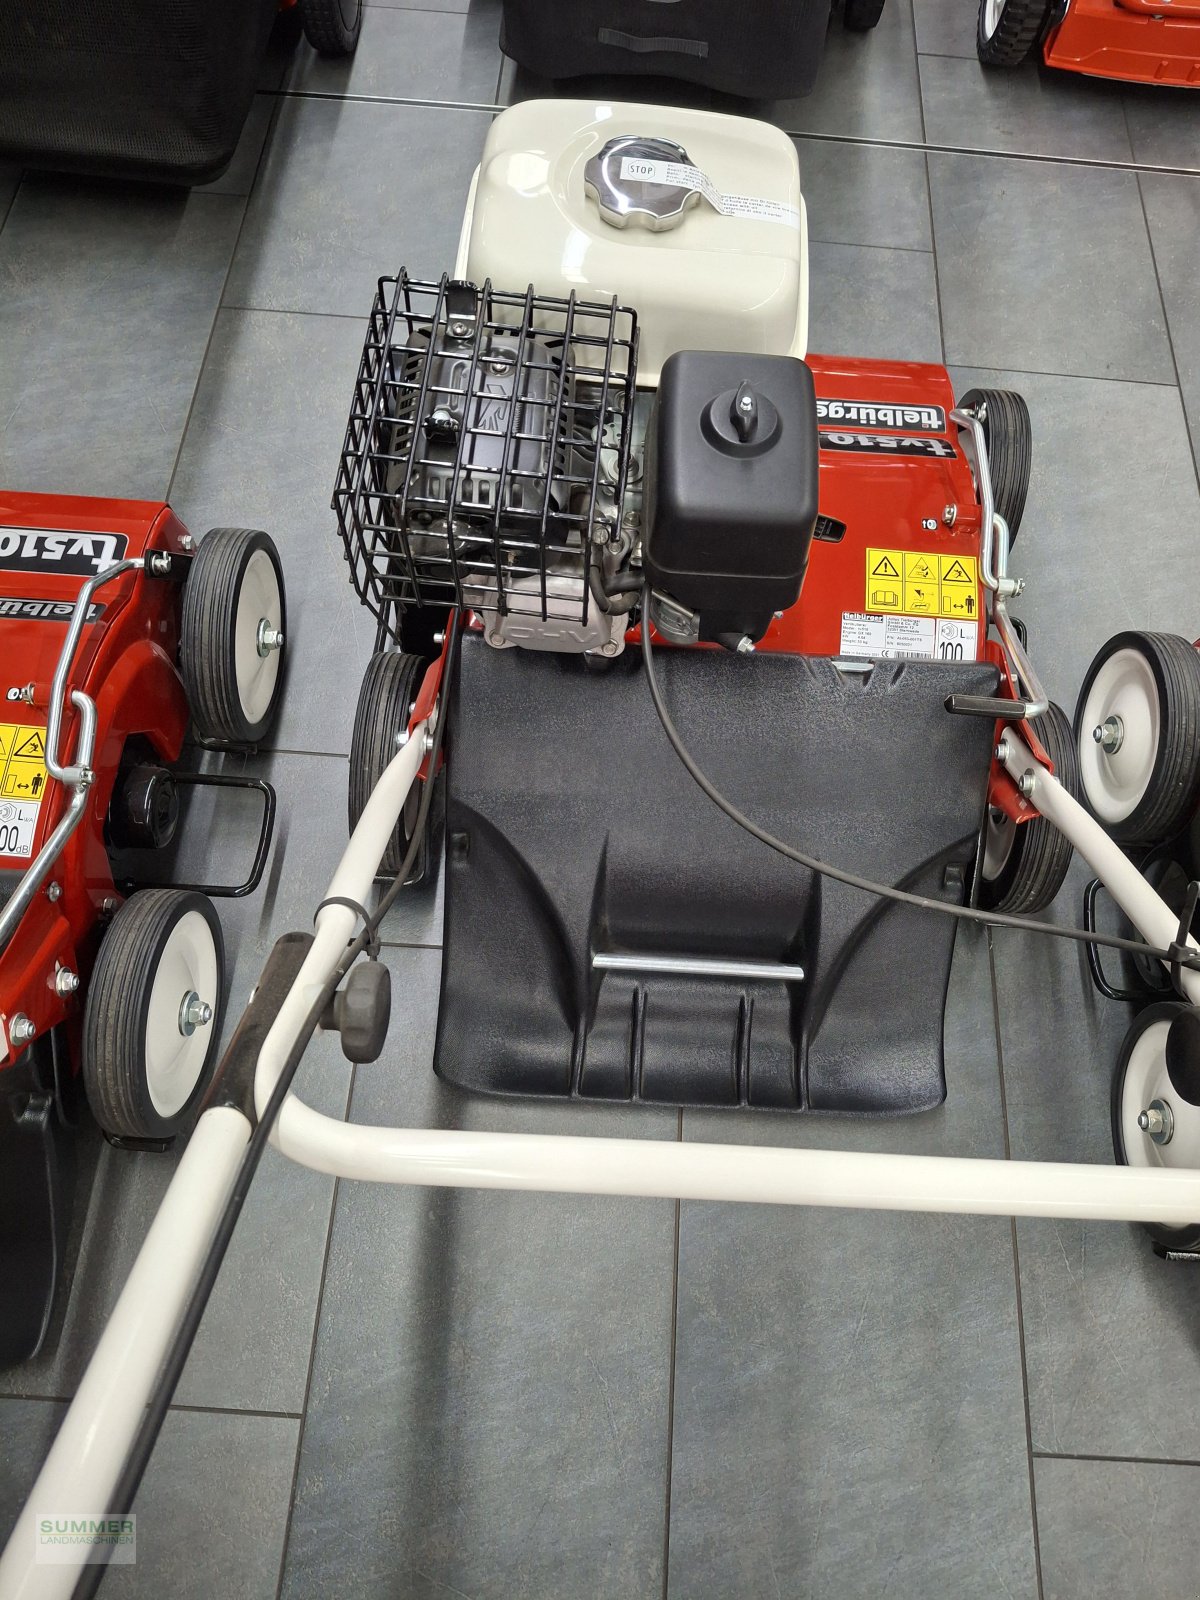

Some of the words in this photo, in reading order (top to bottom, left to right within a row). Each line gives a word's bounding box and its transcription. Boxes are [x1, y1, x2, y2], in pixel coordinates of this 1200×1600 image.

[630, 165, 653, 174] STOP
[825, 433, 952, 456] tv510
[0, 531, 120, 574] tv510
[0, 601, 97, 620] telbü
[940, 641, 963, 660] 100
